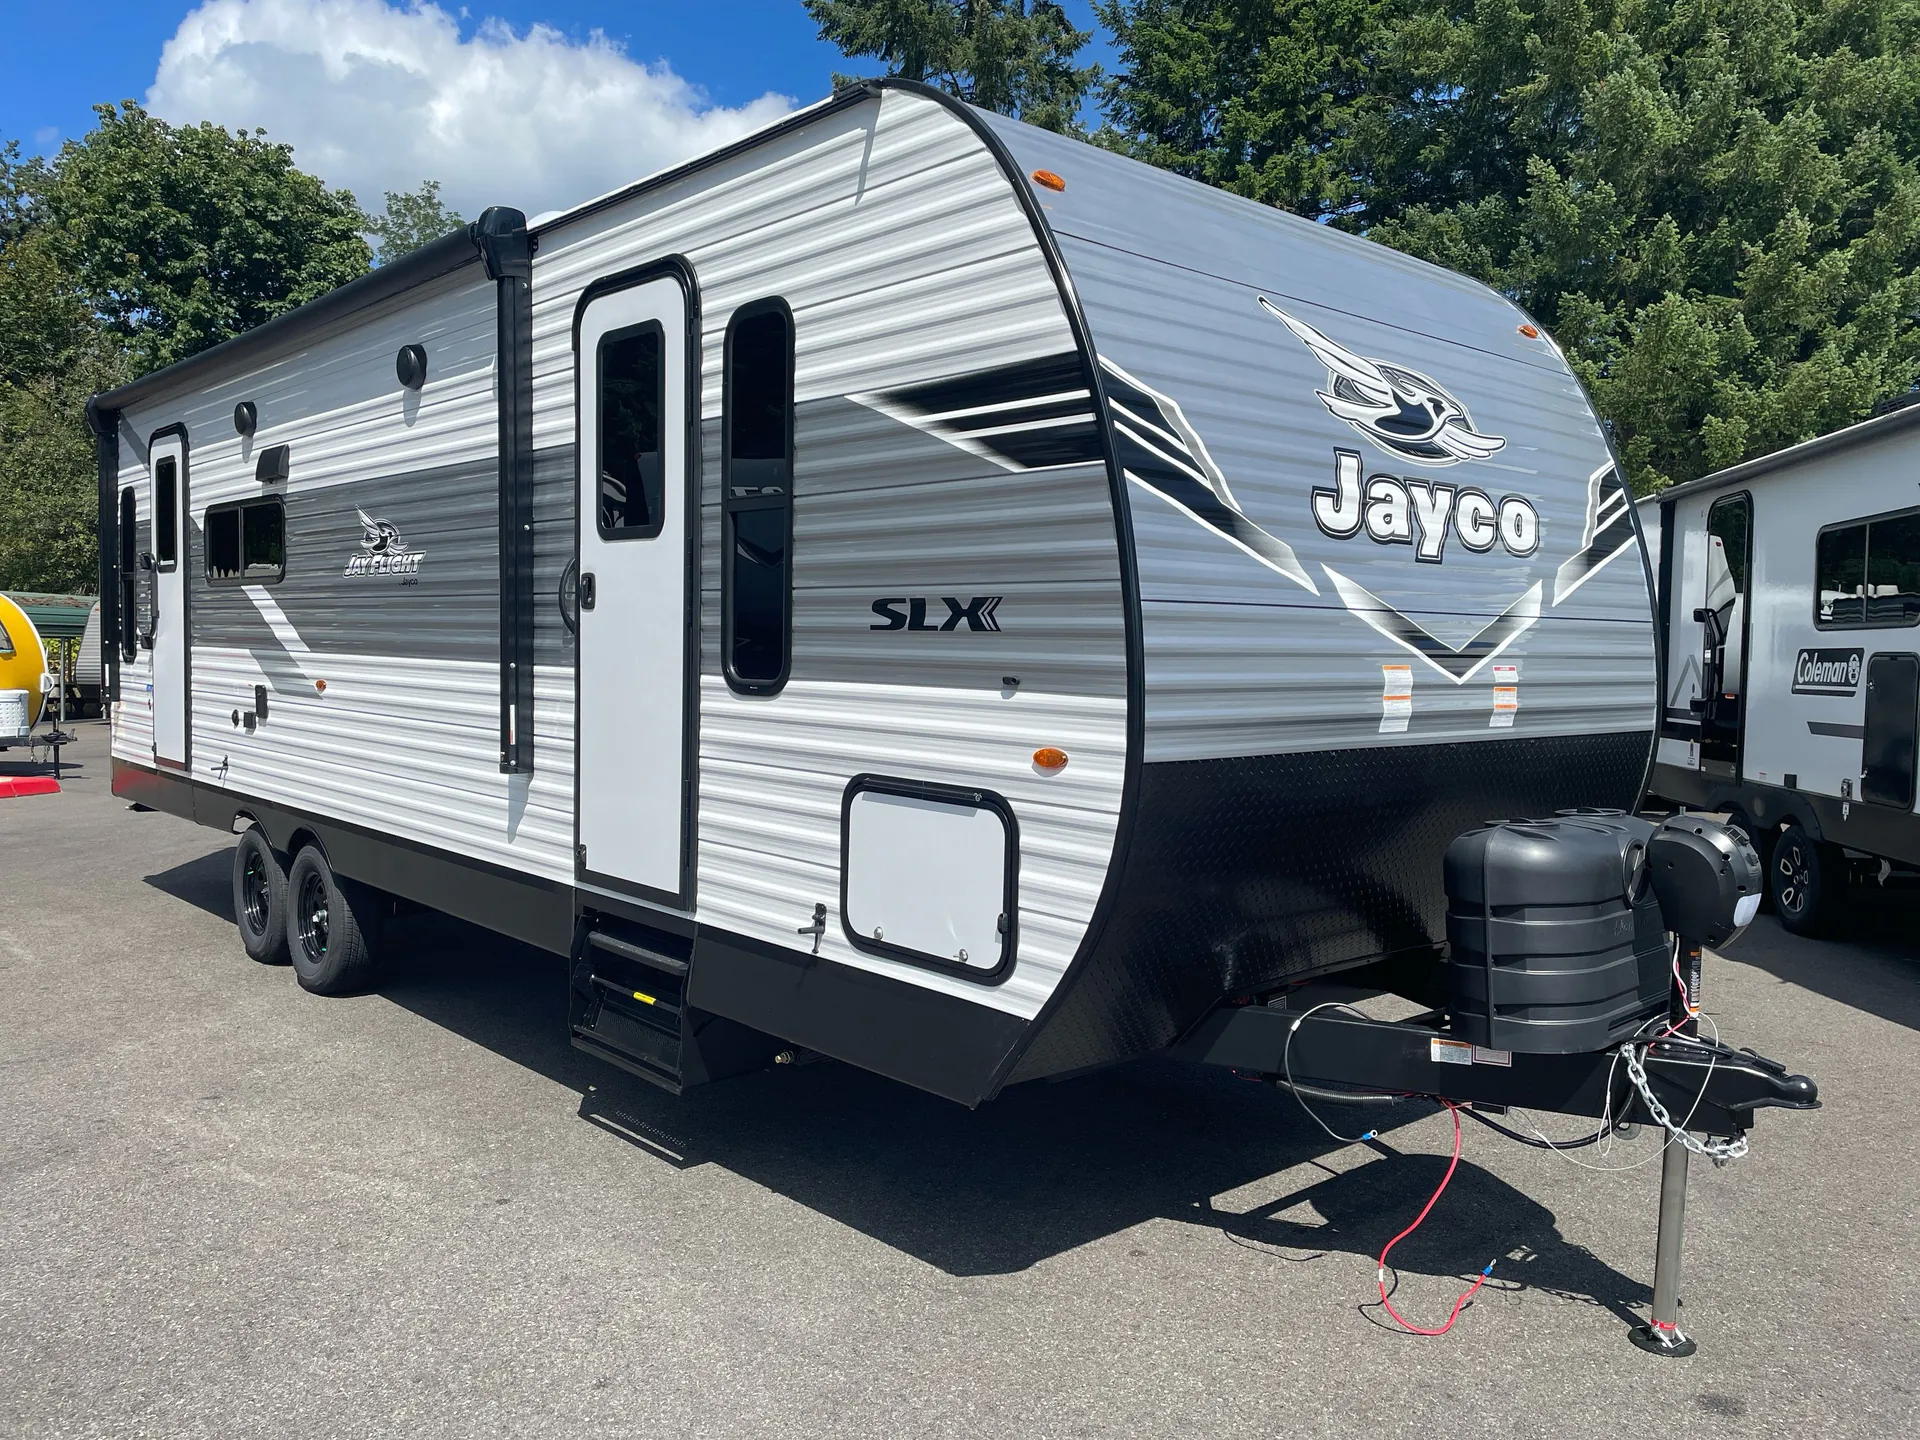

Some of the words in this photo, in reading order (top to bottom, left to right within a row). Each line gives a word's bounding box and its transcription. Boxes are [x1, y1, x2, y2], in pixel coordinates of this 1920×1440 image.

[1311, 446, 1539, 563] Jayco
[343, 553, 371, 578] JAY
[368, 550, 426, 577] FLIGHT
[869, 597, 1003, 632] SLX
[1797, 652, 1848, 684] Coleman
